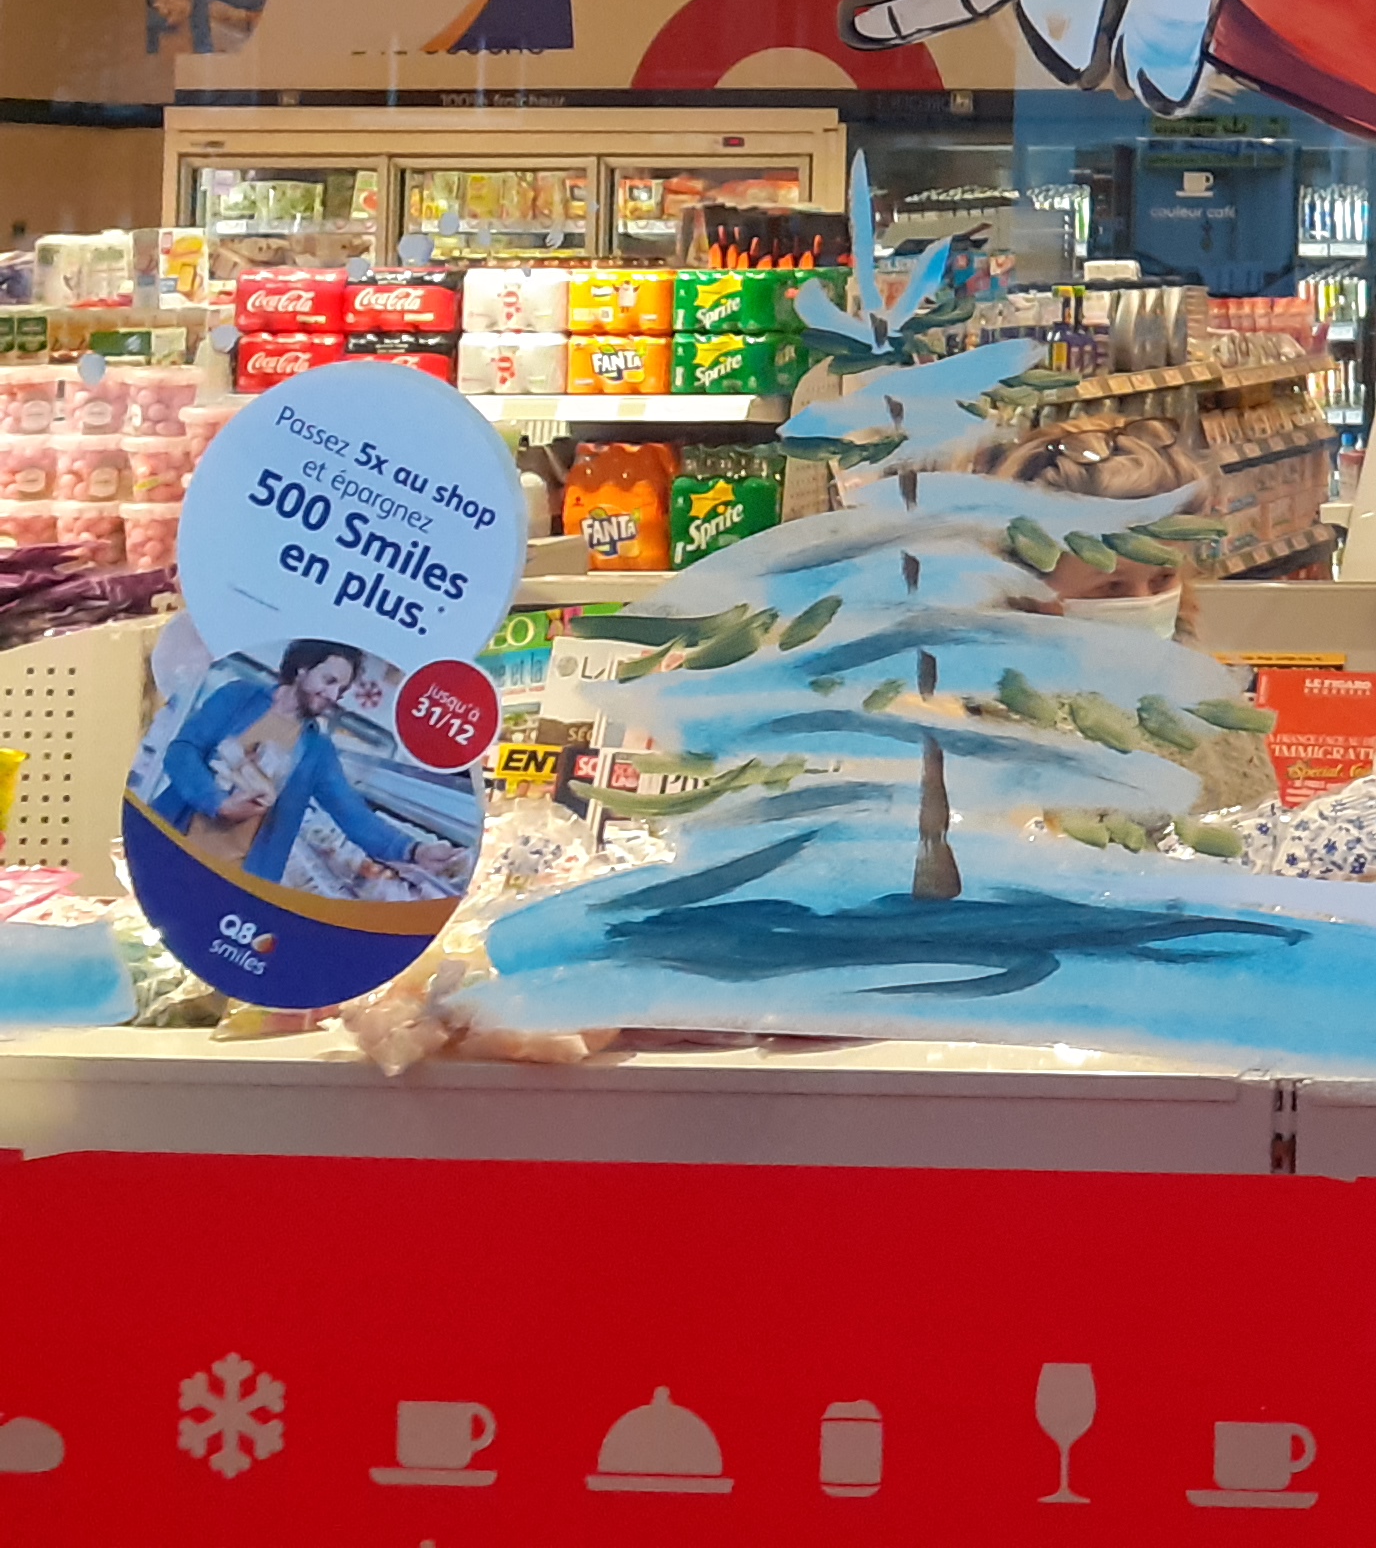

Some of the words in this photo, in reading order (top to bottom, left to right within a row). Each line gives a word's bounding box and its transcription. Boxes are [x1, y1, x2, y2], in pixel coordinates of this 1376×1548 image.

[696, 296, 742, 329] Sprite
[591, 349, 642, 373] FANTA
[695, 353, 743, 386] Sprite
[275, 405, 350, 458] Passez
[353, 441, 389, 476] 5x
[392, 463, 429, 495] au
[432, 483, 497, 530] shop
[301, 458, 324, 484] et
[330, 469, 435, 534] épargnez
[248, 468, 333, 532] 500
[335, 511, 470, 601] Smiles
[581, 512, 637, 546] FANTA
[686, 503, 744, 551] Sprite
[278, 541, 331, 585] en
[411, 697, 475, 746] 31/12
[219, 914, 257, 945] Q8
[208, 938, 267, 975] smiles
